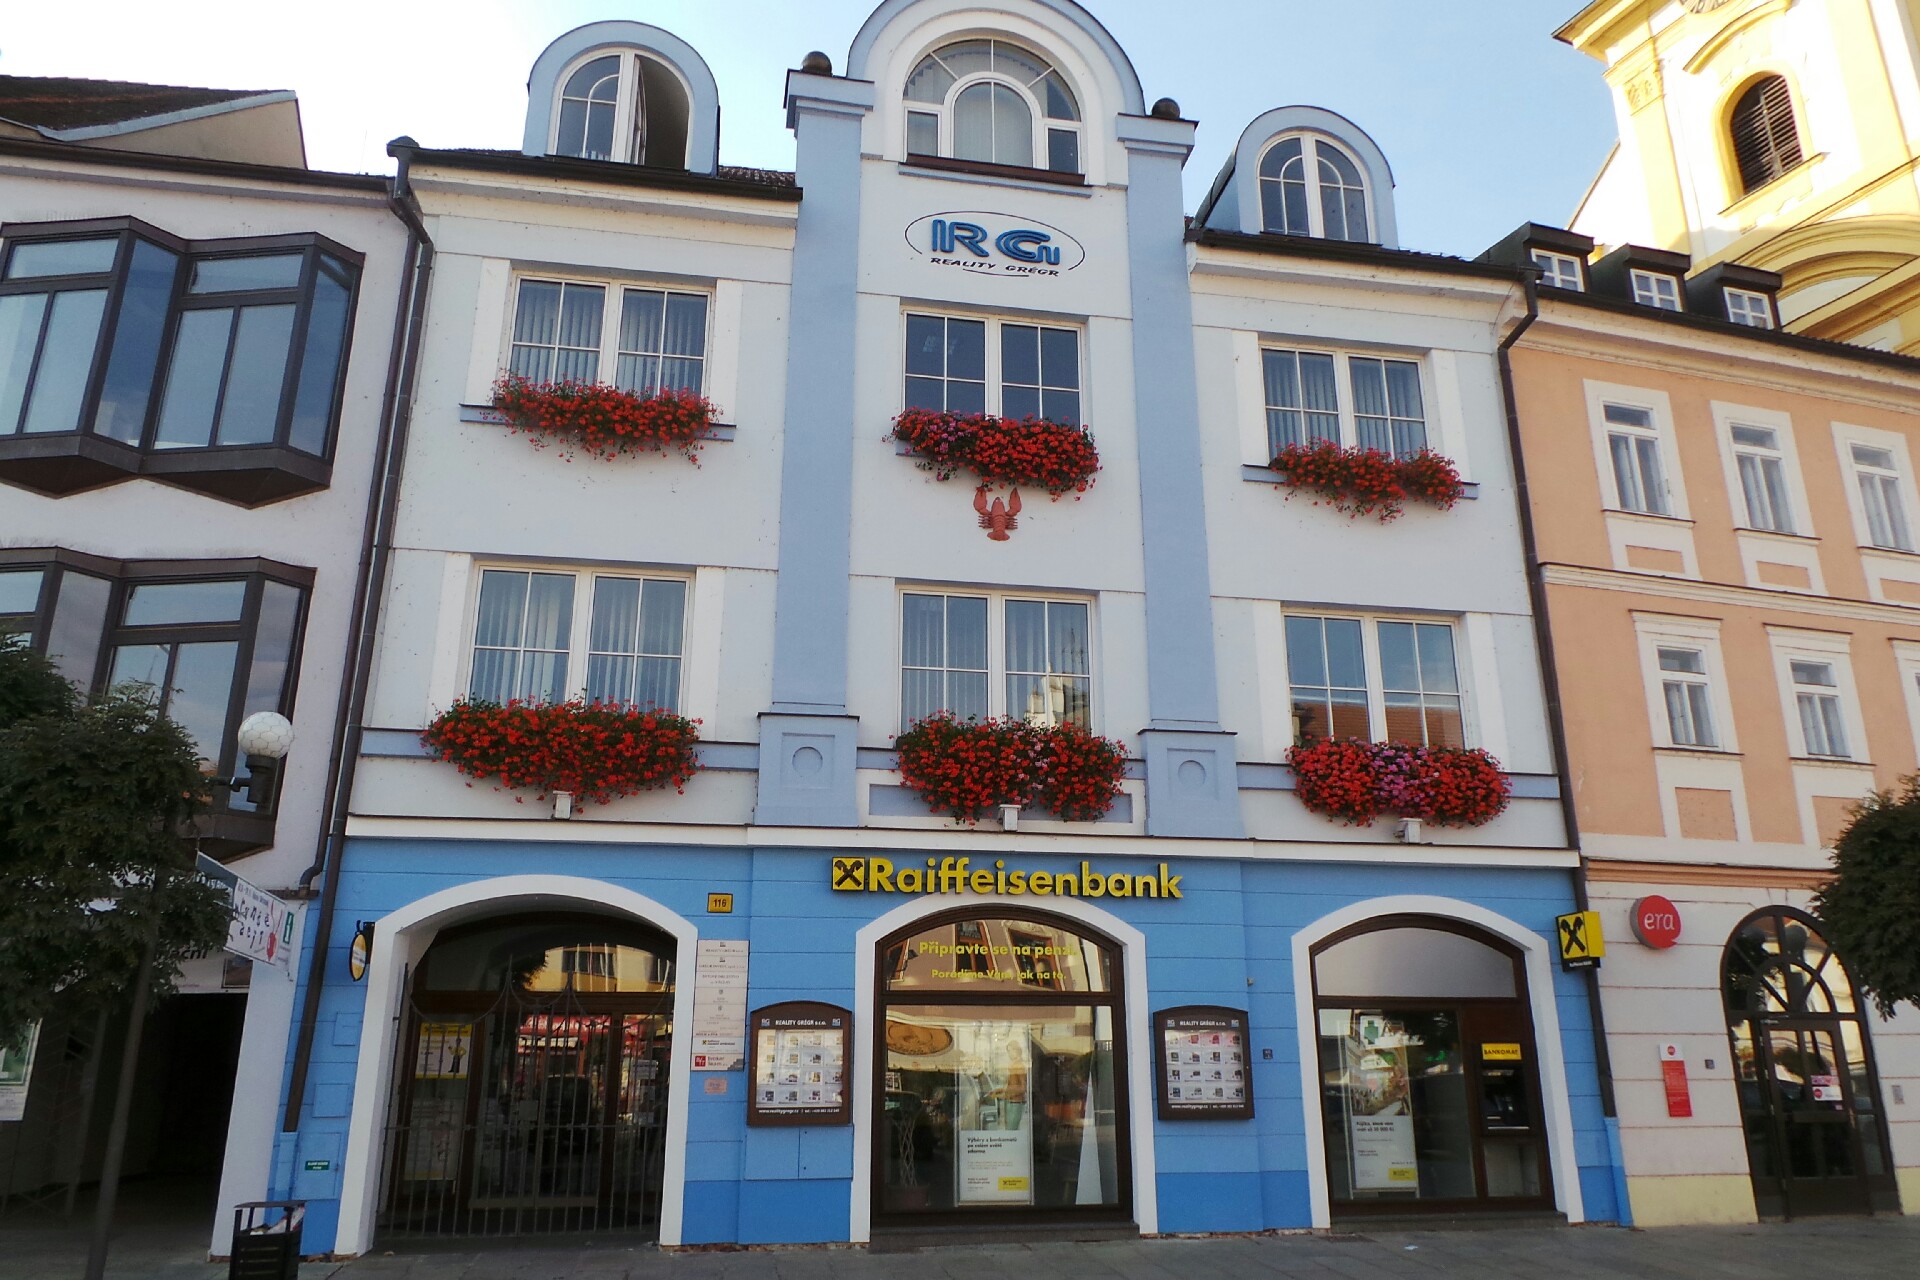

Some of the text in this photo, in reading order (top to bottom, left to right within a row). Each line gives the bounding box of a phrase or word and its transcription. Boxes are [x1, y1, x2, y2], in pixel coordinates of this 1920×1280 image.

[930, 257, 1060, 277] REALITY GRÉGR
[868, 856, 1184, 900] Raiffeisenbank
[713, 898, 727, 907] 116
[1644, 912, 1675, 931] era
[919, 941, 988, 957] Připravte
[991, 944, 1008, 956] se
[1012, 944, 1031, 956] na
[1036, 971, 1050, 979] na
